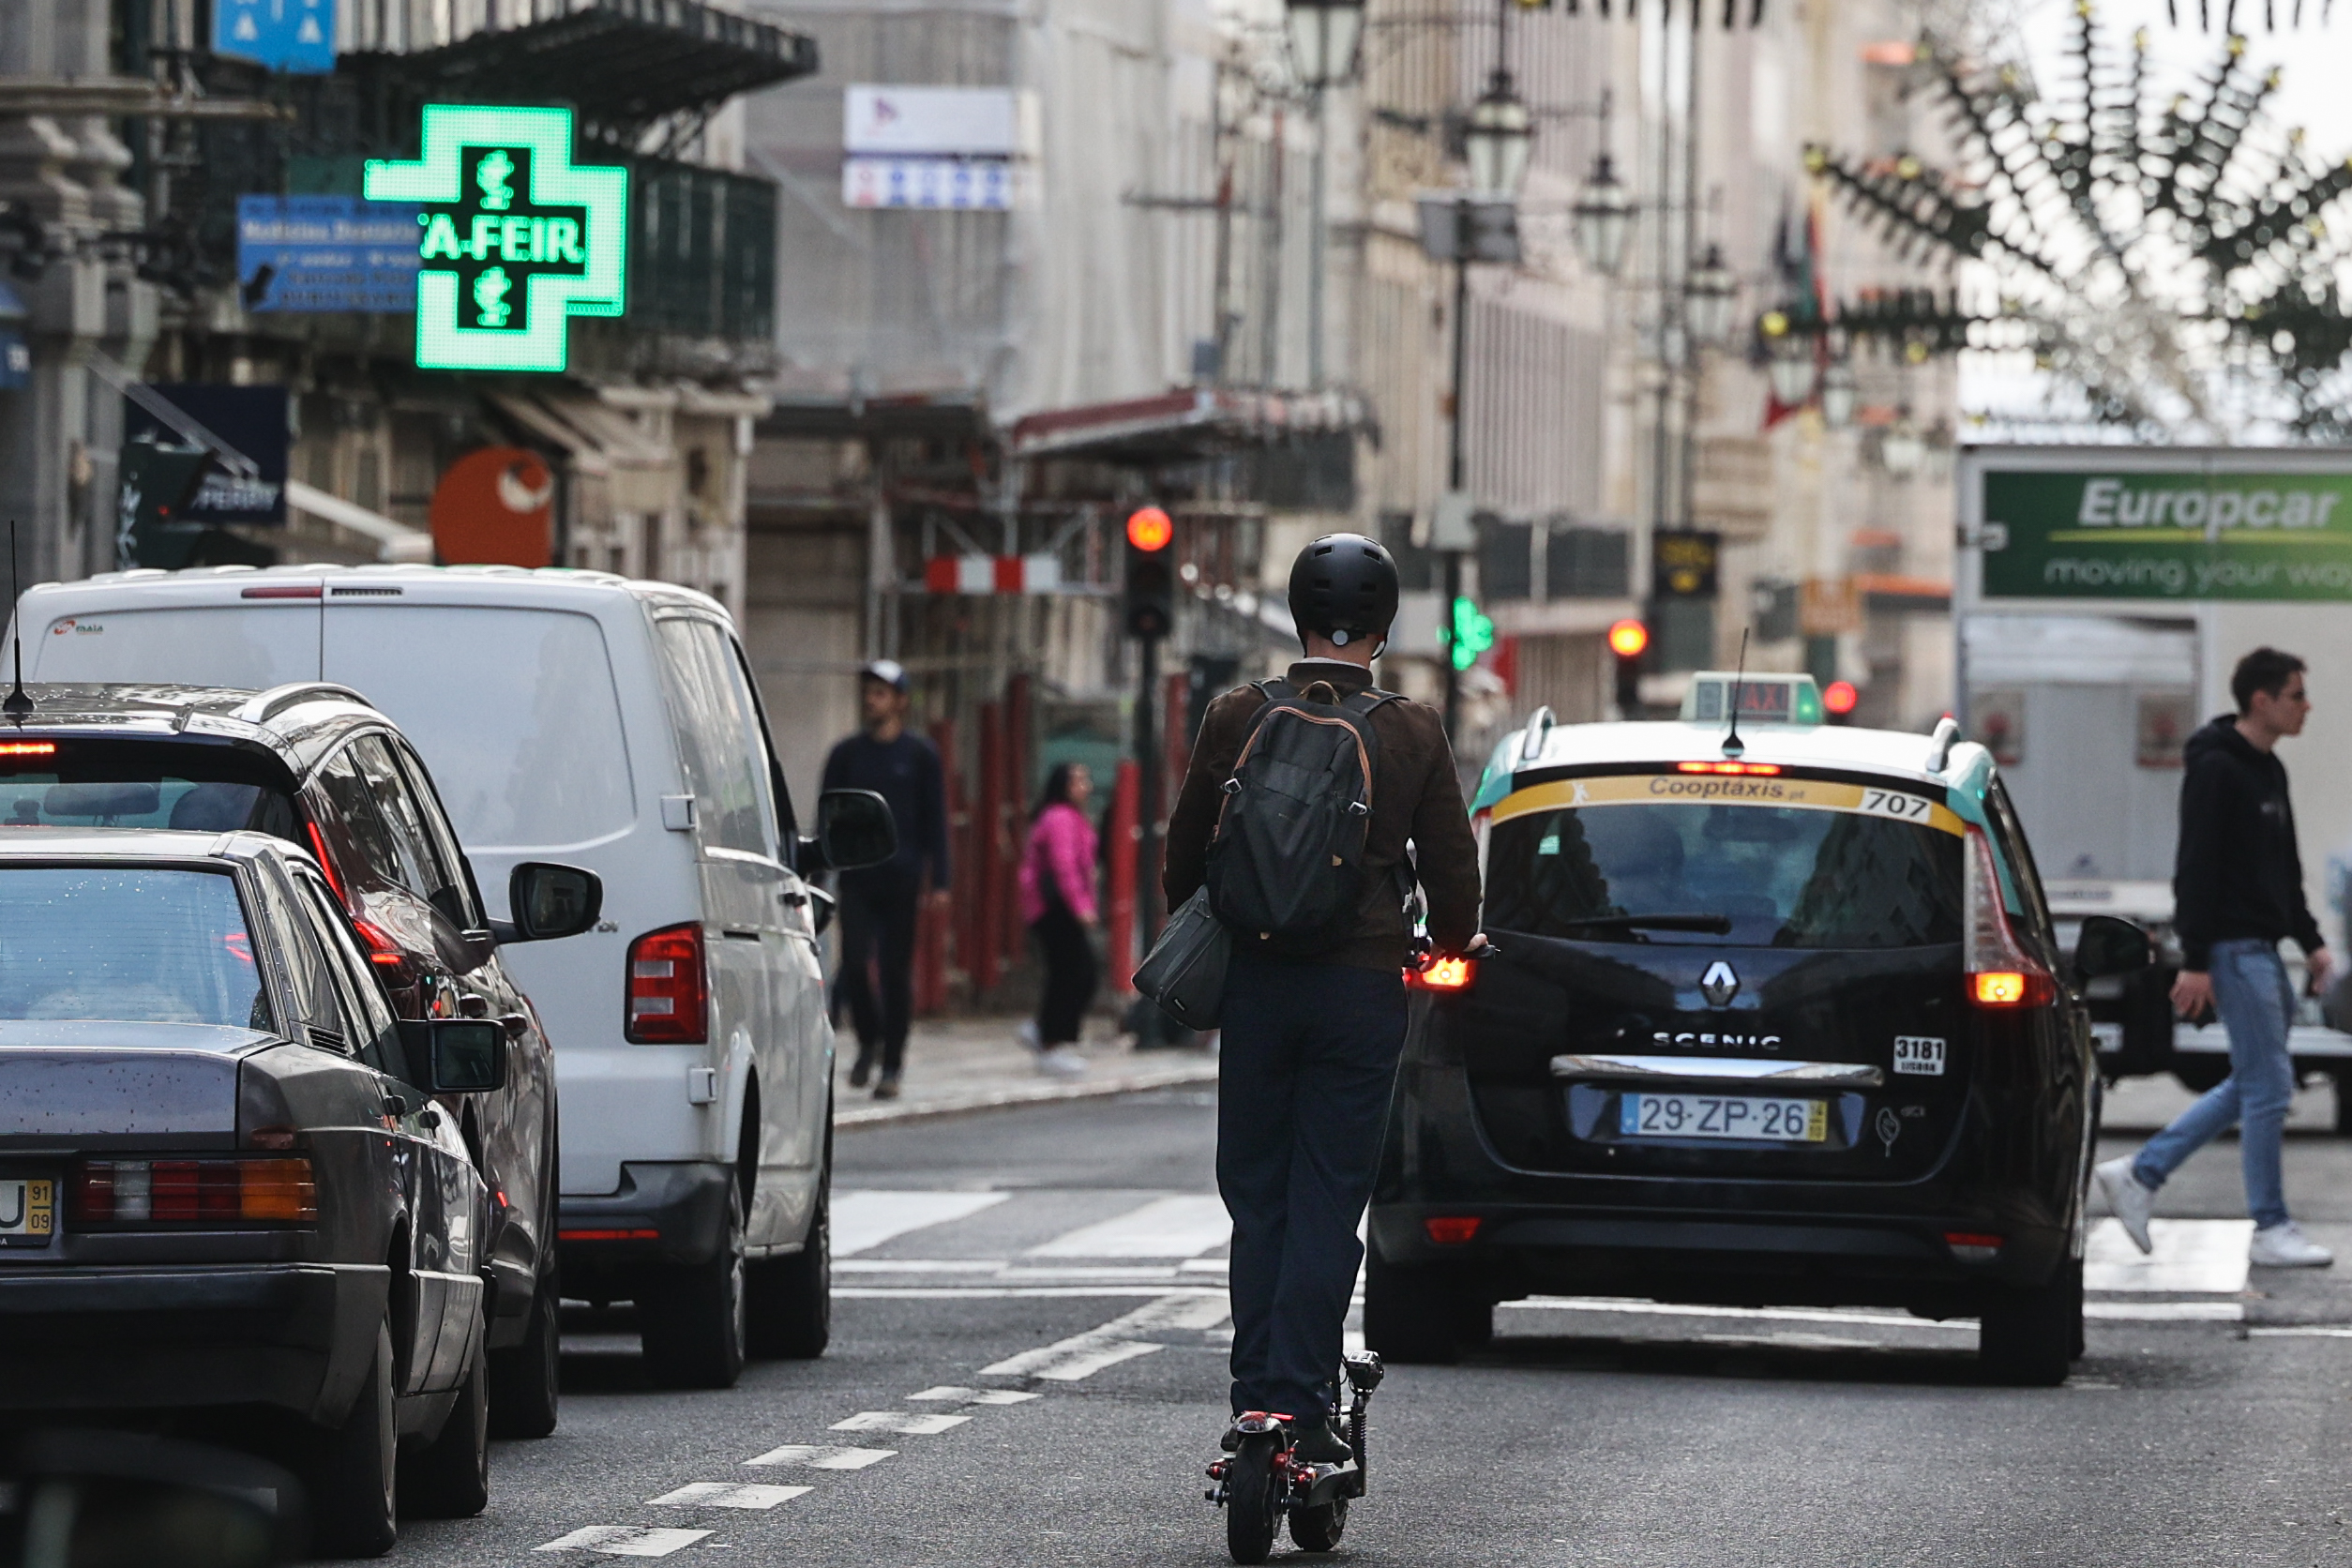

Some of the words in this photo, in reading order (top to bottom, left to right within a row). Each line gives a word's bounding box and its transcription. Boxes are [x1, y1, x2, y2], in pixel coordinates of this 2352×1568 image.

[2078, 477, 2341, 543] Europcar
[2043, 557, 2188, 595] moving
[2194, 557, 2279, 595] your
[1867, 791, 1929, 818] 707
[1652, 1031, 1782, 1051] SCENIC
[1897, 1039, 1944, 1062] 3181
[32, 1185, 49, 1201] 91
[31, 1214, 50, 1229] 09
